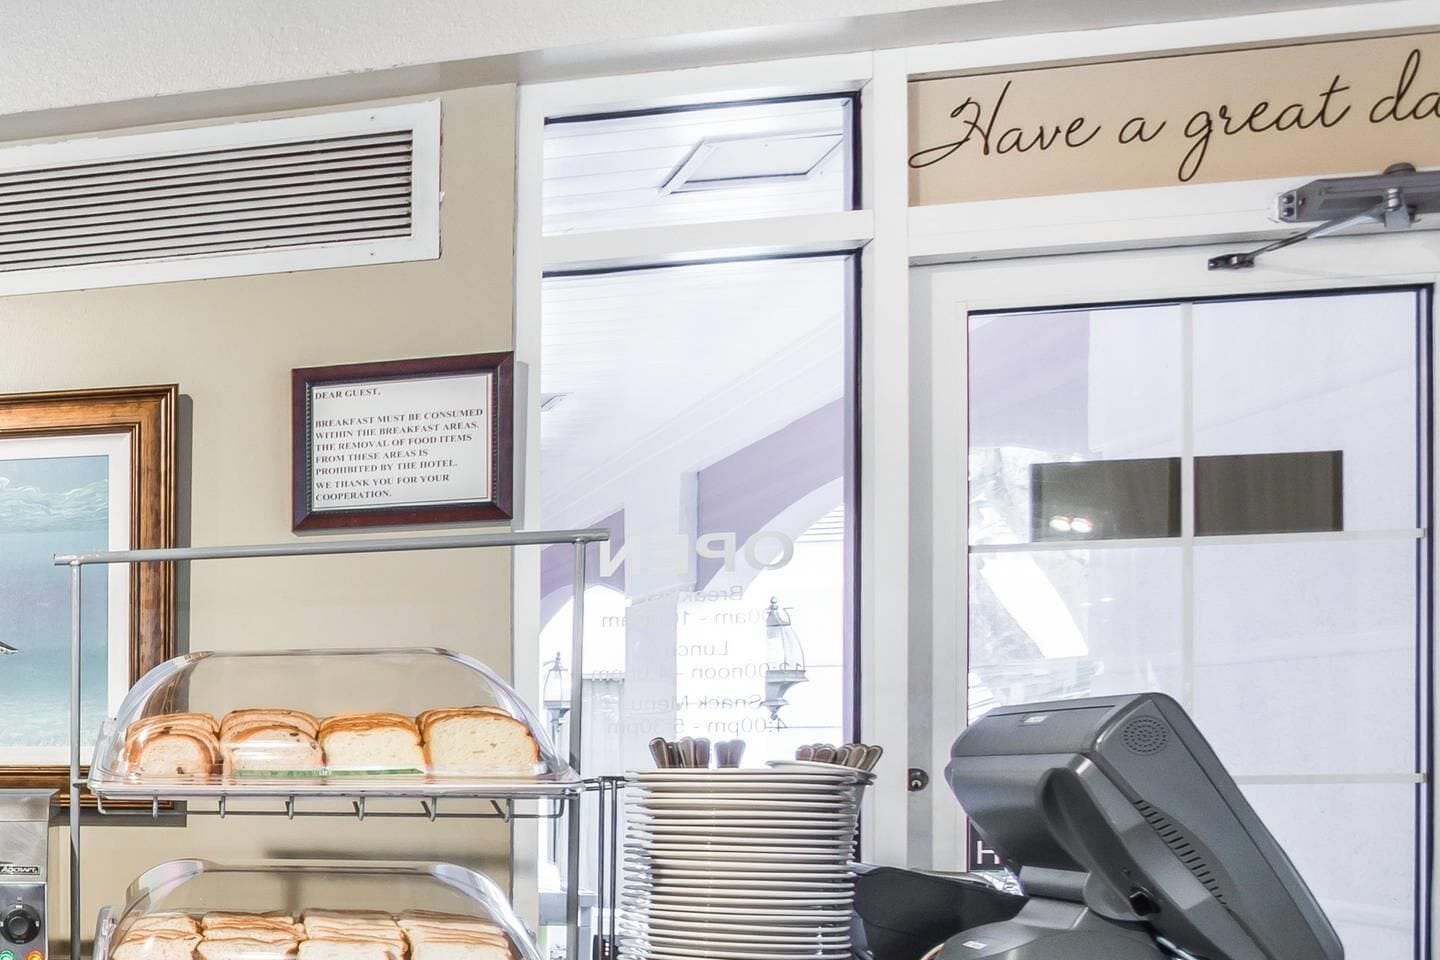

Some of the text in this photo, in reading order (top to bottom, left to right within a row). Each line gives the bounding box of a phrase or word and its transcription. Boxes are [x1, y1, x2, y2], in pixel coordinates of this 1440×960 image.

[907, 80, 1101, 169] Have
[1118, 116, 1166, 144] a
[1178, 75, 1351, 182] great
[315, 390, 343, 401] DEAR
[315, 408, 484, 429] BREAKFAST MUST BE CONSUMED
[315, 421, 480, 440] WITHIN THE BREAKFAST AREAS.
[315, 433, 473, 453] THE REMOVAL OF FOOD ITEMS
[315, 448, 429, 465] FROM THESE AREAS IS
[315, 464, 378, 477] PROHIBITED
[380, 463, 394, 472] BY
[396, 461, 417, 471] THE
[315, 473, 450, 490] WE THANK YOU FOR YOUR
[315, 489, 392, 502] COOPERATION.
